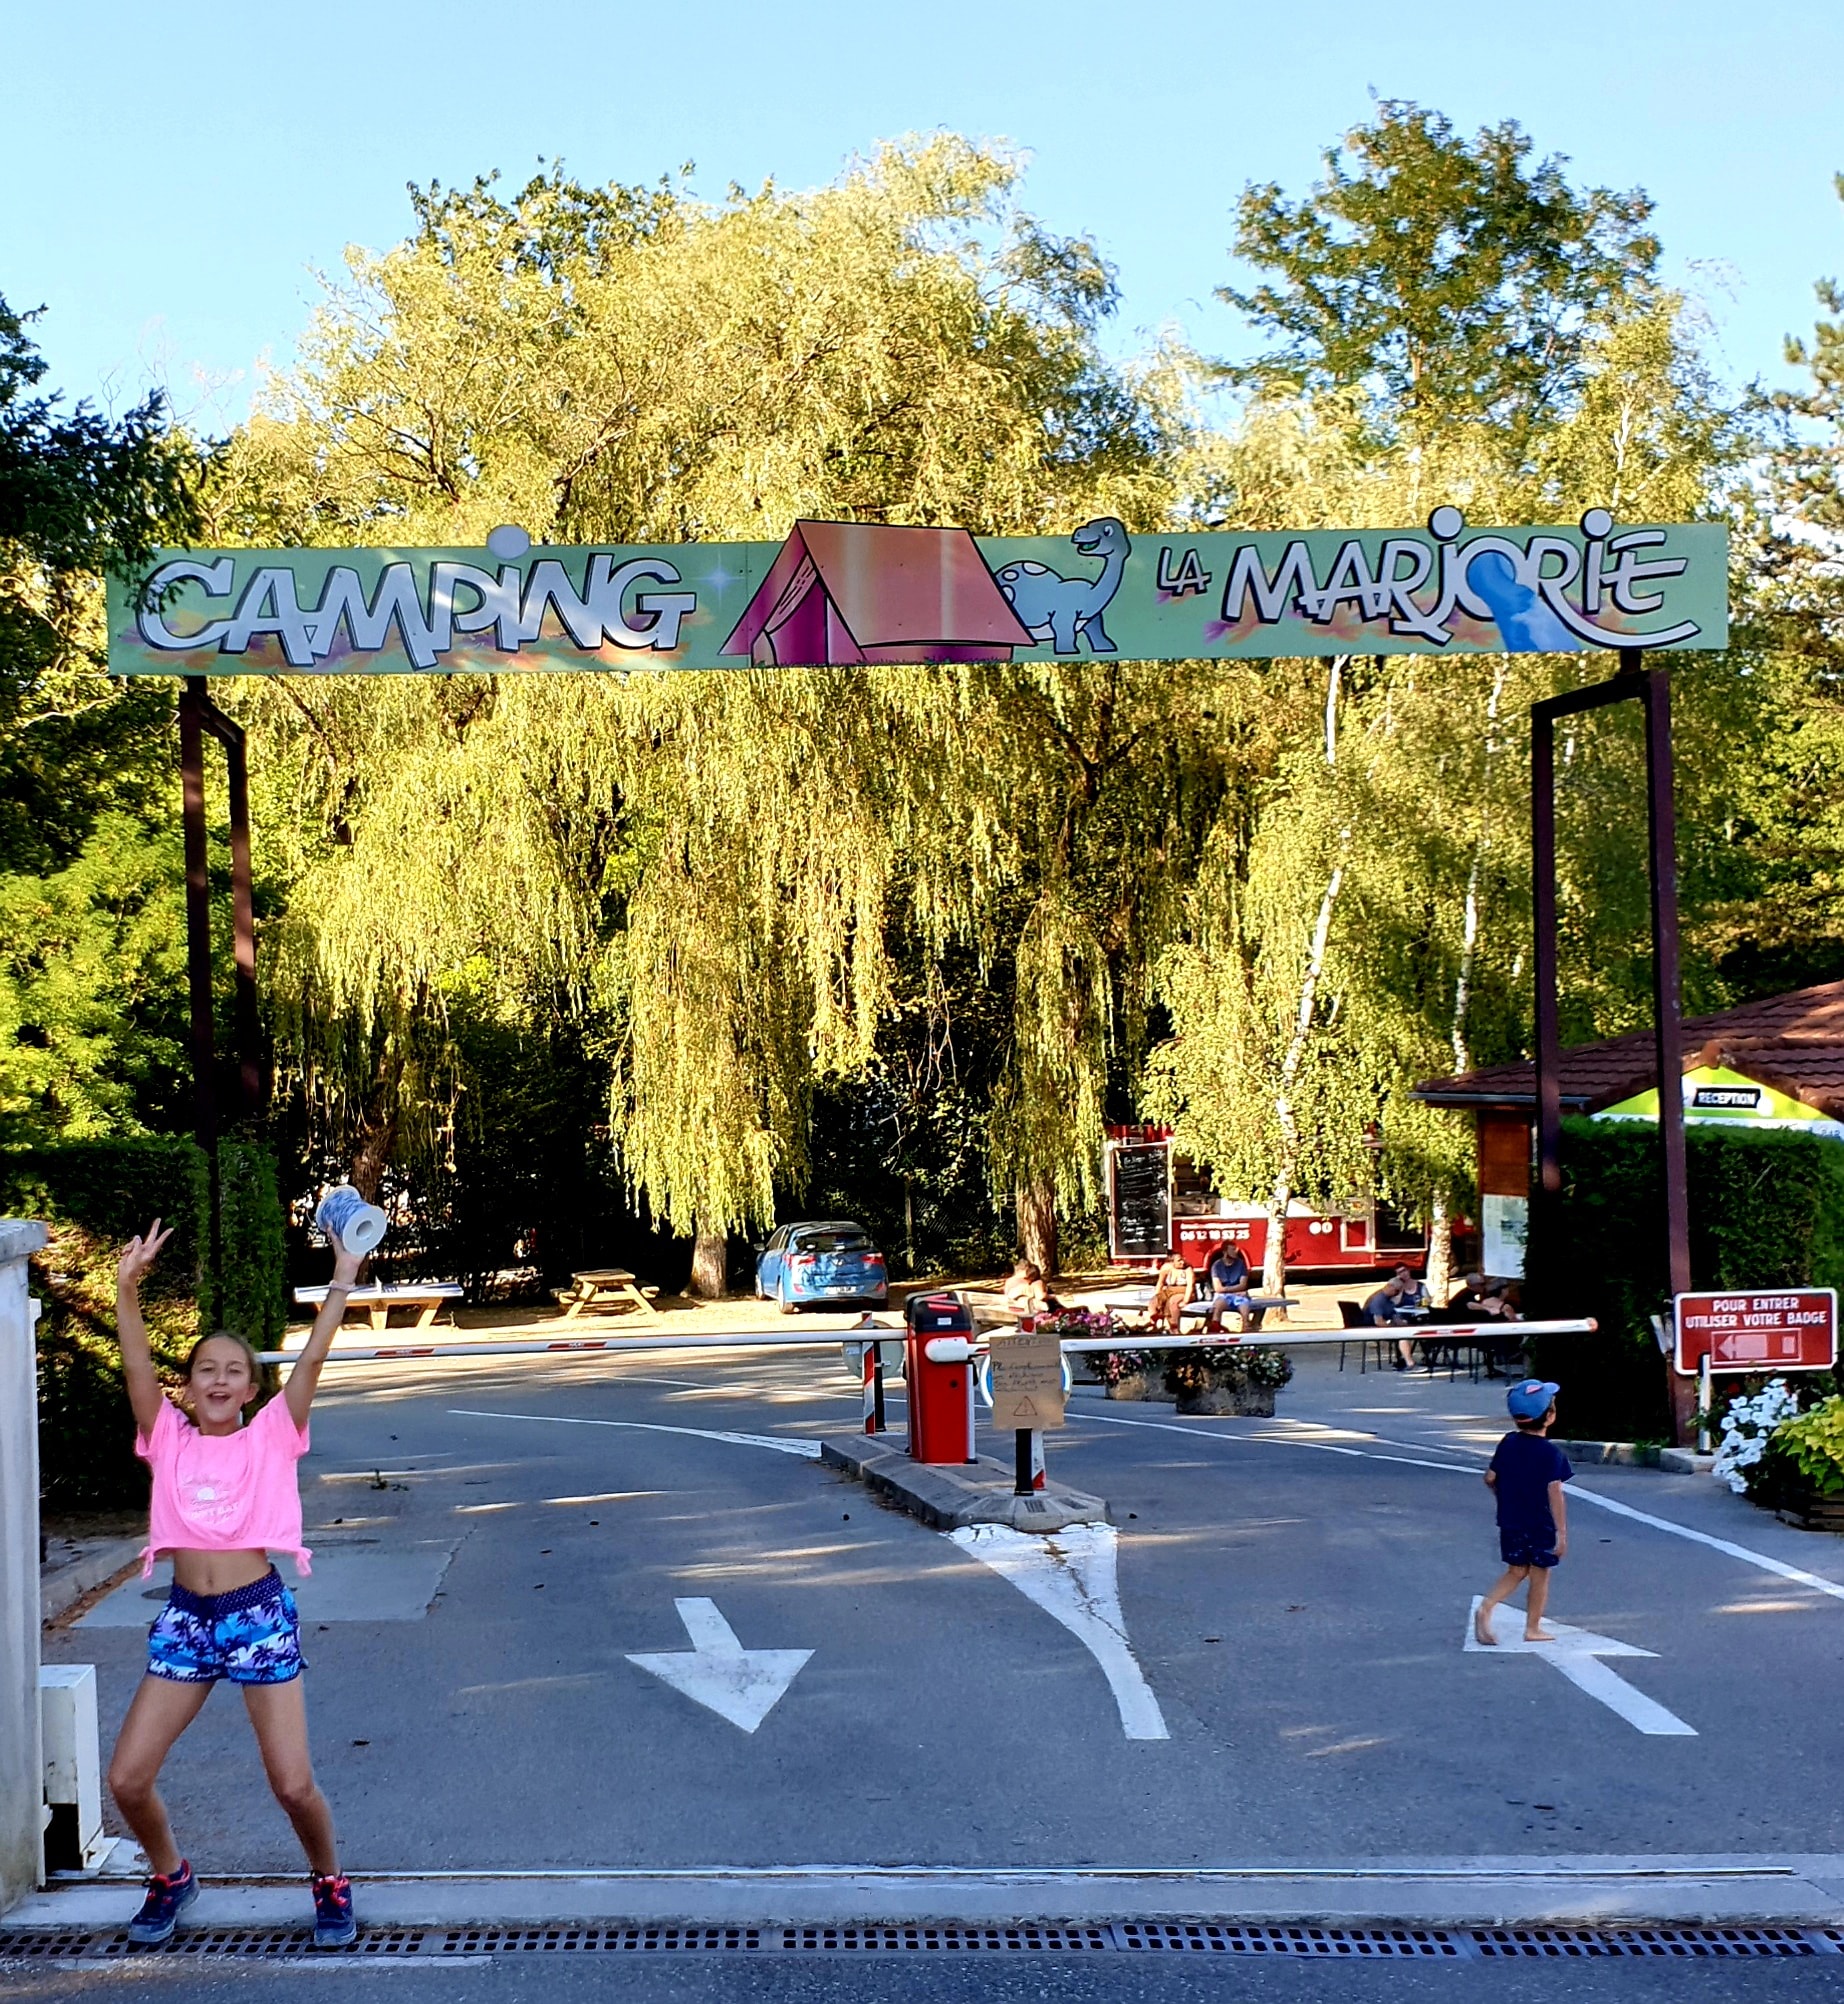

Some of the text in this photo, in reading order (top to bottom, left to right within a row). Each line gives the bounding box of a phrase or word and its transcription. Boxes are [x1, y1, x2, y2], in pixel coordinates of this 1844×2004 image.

[1157, 546, 1211, 596] LA
[1712, 1297, 1800, 1313] POUR ENTRER
[1685, 1310, 1828, 1329] UTILISER VOTRE BADGE
